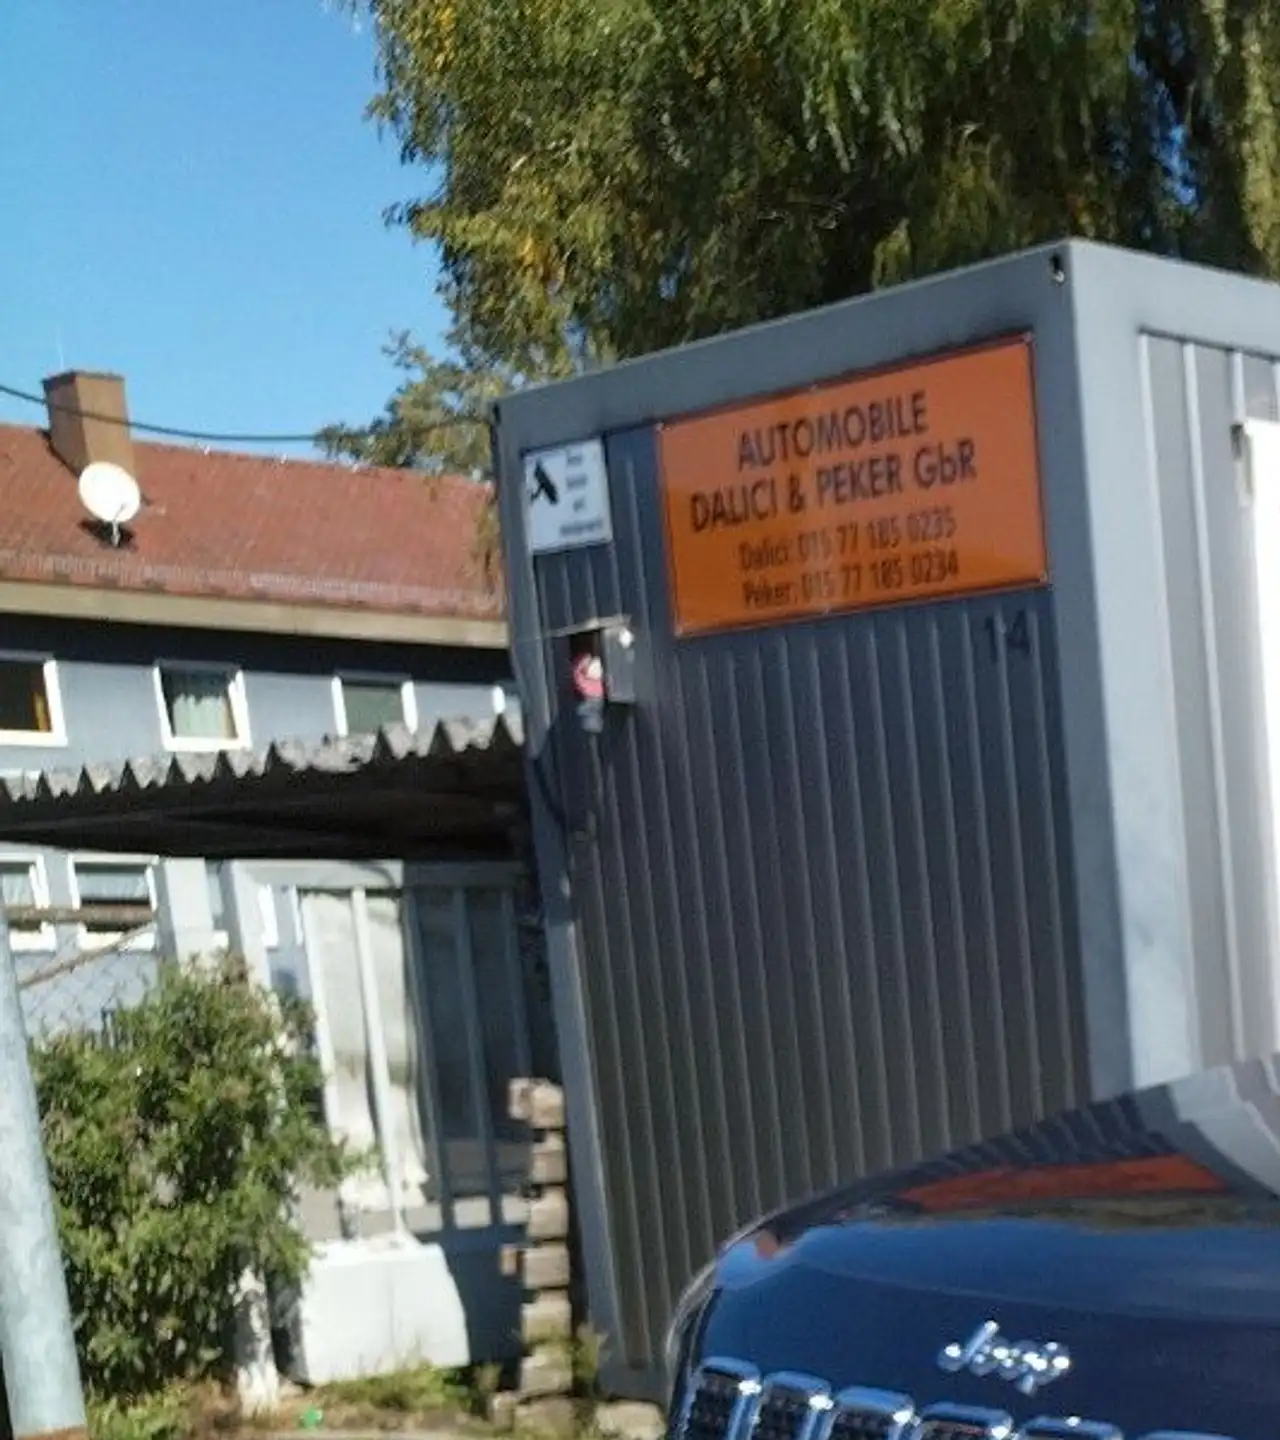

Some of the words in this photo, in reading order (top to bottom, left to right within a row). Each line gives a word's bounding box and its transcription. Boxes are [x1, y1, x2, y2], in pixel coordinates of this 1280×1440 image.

[738, 389, 928, 472] AUTOMOBILE
[690, 477, 777, 532] DALICI
[789, 472, 805, 513] &
[816, 453, 903, 508] PEKER
[913, 437, 977, 490] GbR
